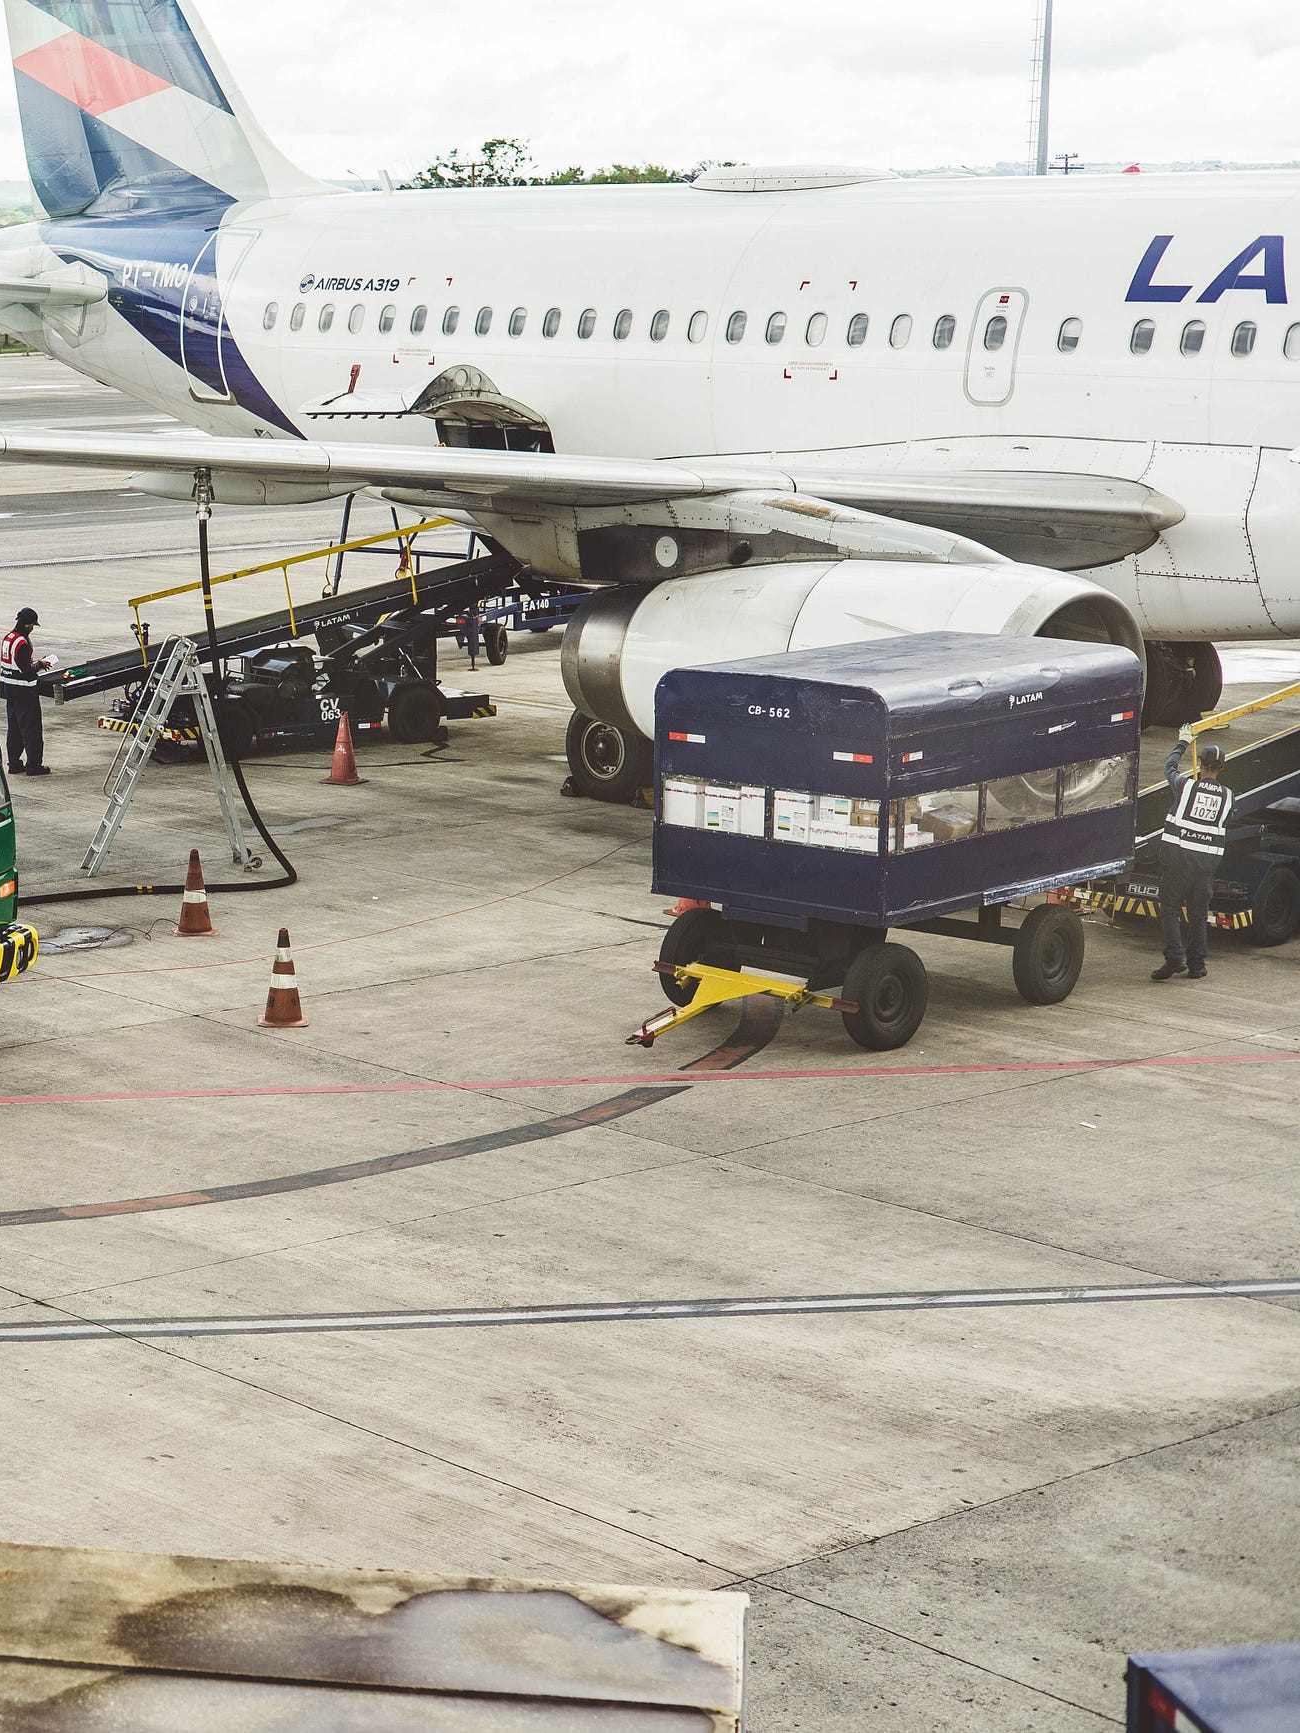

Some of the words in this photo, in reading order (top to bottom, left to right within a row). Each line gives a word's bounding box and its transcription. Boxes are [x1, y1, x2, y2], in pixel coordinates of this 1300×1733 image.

[1124, 235, 1288, 304] LA
[315, 277, 362, 291] AIRBUS
[364, 278, 400, 292] A319
[523, 599, 549, 612] EA140
[321, 614, 351, 627] LATAM
[320, 698, 340, 712] CV
[1016, 692, 1043, 705] LATAM
[321, 709, 341, 721] 063
[769, 707, 790, 718] 562
[1198, 782, 1223, 793] RAMPA
[1196, 797, 1219, 808] LTM
[1194, 807, 1217, 820] 1073
[1187, 832, 1213, 842] LATAM
